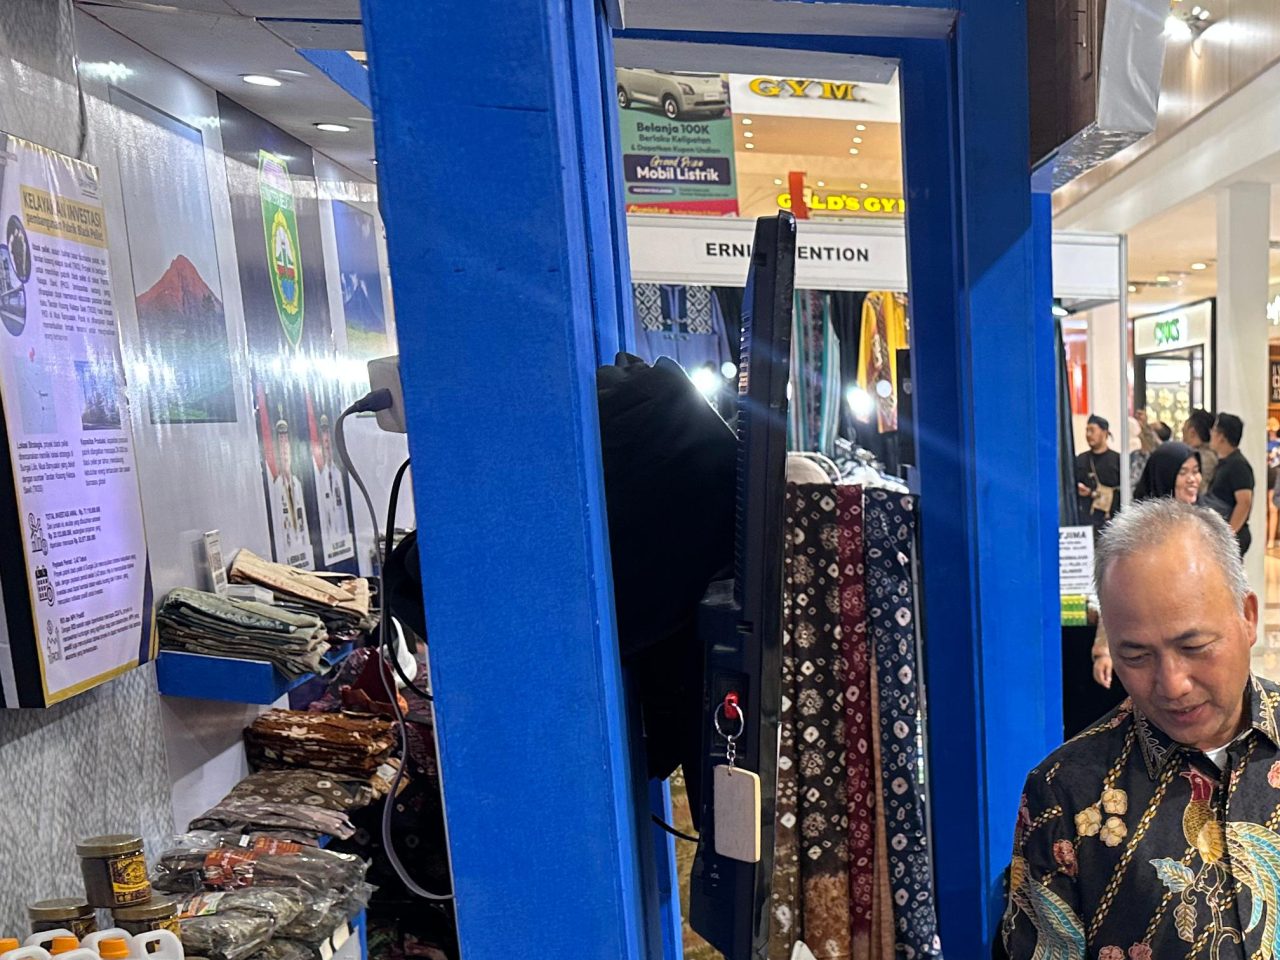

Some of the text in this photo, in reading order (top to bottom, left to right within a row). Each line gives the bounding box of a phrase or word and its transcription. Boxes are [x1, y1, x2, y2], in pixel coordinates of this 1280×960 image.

[636, 122, 710, 135] Belanja 100K
[636, 166, 719, 181] Mobil Listrik
[777, 193, 859, 211] GLD'S
[67, 203, 102, 228] INVESTASI
